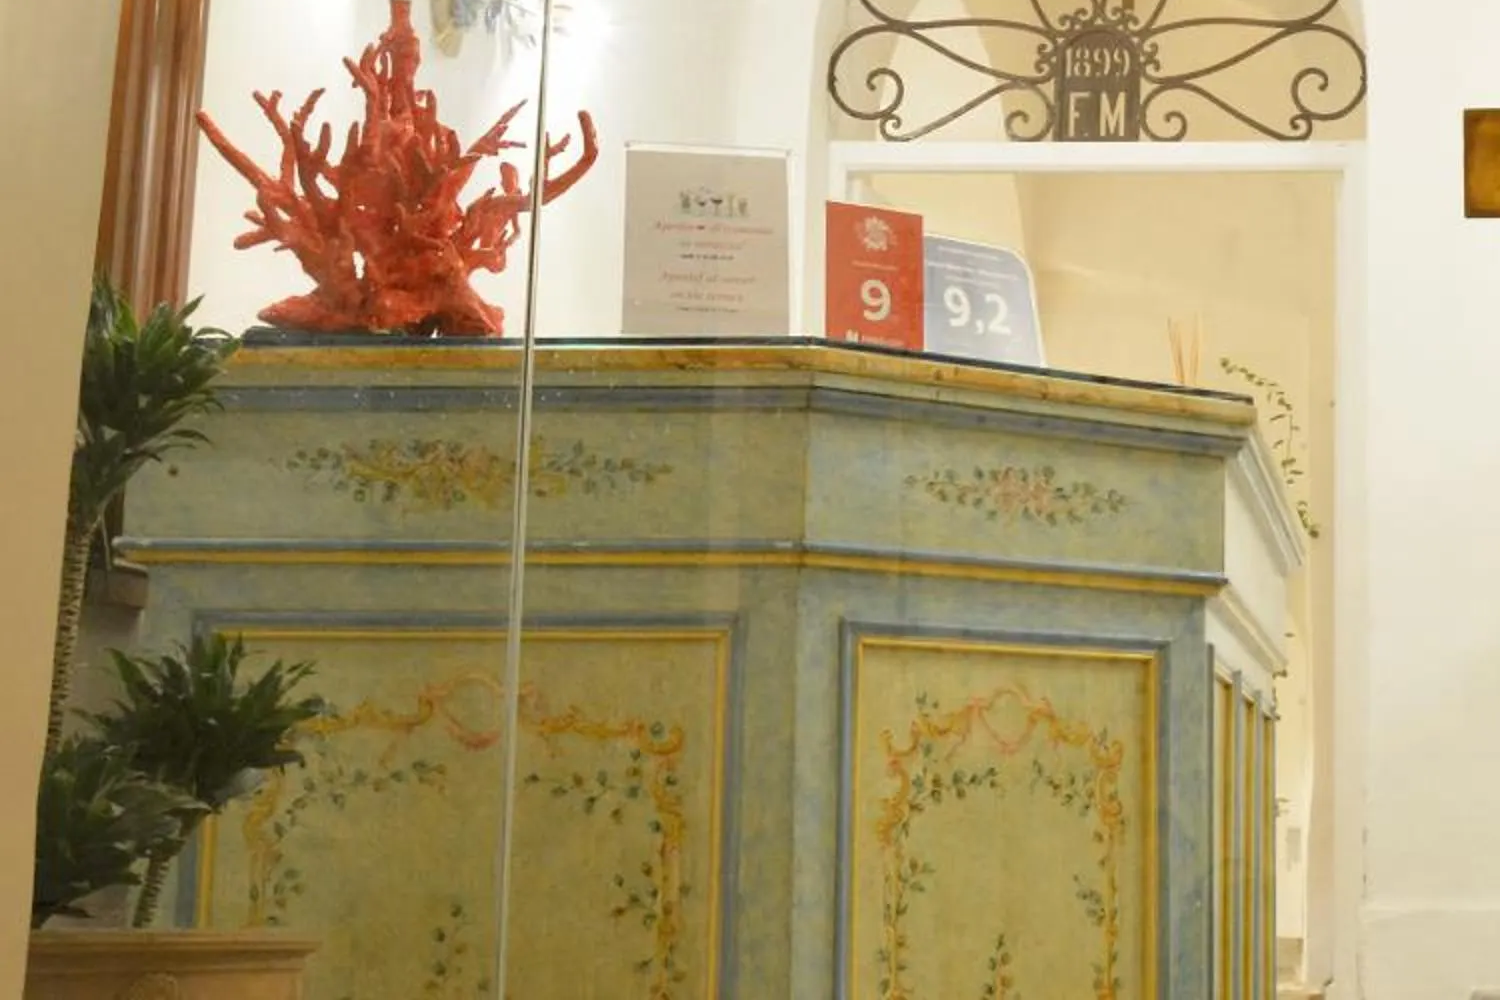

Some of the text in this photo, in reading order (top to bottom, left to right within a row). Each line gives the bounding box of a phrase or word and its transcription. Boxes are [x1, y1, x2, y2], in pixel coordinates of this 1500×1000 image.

[1065, 46, 1131, 77] 1899
[860, 279, 892, 321] 9
[943, 286, 1012, 335] 9,2
